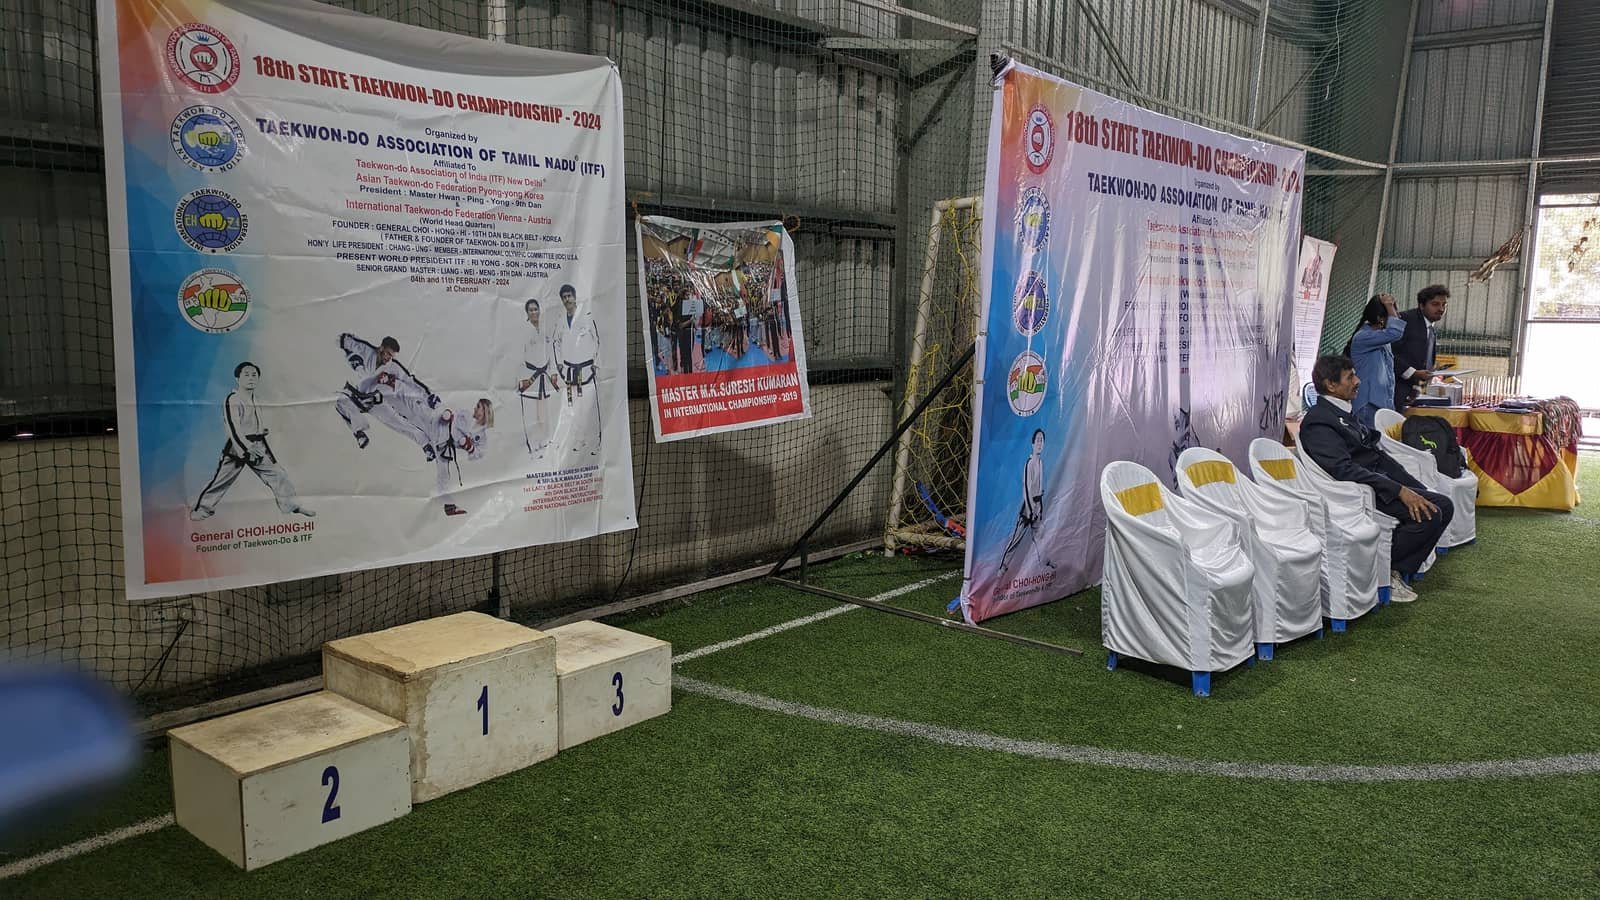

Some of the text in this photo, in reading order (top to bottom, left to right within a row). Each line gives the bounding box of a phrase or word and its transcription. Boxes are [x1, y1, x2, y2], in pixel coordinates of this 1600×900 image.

[253, 55, 295, 80] 18th
[298, 63, 349, 90] STATE
[350, 73, 454, 108] TAEKWON-DO
[456, 93, 562, 124] CHAMPIONSHIP
[573, 110, 601, 130] 2024
[425, 127, 478, 144] Organized by
[256, 118, 369, 145] TAEKWON-DO
[376, 135, 473, 160] ASSOCIATION
[479, 149, 497, 162] OF
[502, 152, 540, 168] TAMIL
[580, 161, 605, 179] (ITF)
[1067, 110, 1099, 147] 18th
[1101, 118, 1139, 156] STATE
[1141, 129, 1212, 173] TAEKWON-DO
[1213, 148, 1277, 187] CHAMPIONSHIP
[356, 159, 408, 173] Taekwon-do
[410, 165, 457, 178] Association
[460, 171, 467, 179] of
[469, 172, 488, 182] India
[489, 175, 506, 184] (ITF)
[508, 177, 523, 185] New
[433, 159, 477, 171] Affiliated To
[356, 172, 545, 200] Asian Taekwon-do Federation Pyong-yong Korea
[359, 184, 402, 196] President
[409, 190, 436, 199] Master
[438, 192, 460, 201] Hwan
[467, 195, 484, 205] Ping
[491, 199, 510, 208] Yong
[1088, 172, 1157, 201] TAEKWON-DO
[1221, 197, 1233, 214] OF
[345, 199, 552, 225] International Taekwon-do Federation Vienna Austria
[445, 219, 463, 227] Head
[224, 213, 249, 253] FEDERATION
[332, 220, 370, 230] FOUNDER
[376, 223, 411, 233] GENERAL
[412, 225, 430, 234] CHOI
[434, 228, 455, 236] HONG
[488, 231, 502, 239] DAN
[502, 232, 524, 240] BLACK
[524, 233, 539, 241] BELT
[542, 235, 562, 243] KOREA
[421, 235, 454, 244] FOUNDER
[455, 237, 464, 245] OF
[332, 240, 347, 249] LIFE
[348, 241, 384, 250] PRESIDENT
[389, 244, 411, 252] CHANG
[415, 245, 428, 253] UNG
[434, 246, 458, 255] MEMBER
[462, 248, 504, 257] INTERNATIONAL
[336, 252, 377, 261] PRESENT
[378, 254, 409, 263] WORLD
[410, 256, 452, 265] PRESIDENT
[480, 259, 500, 267] YONG
[505, 260, 520, 268] SON
[524, 261, 538, 269] DPR
[538, 262, 561, 270] KOREA
[356, 263, 382, 272] SENIOR
[383, 265, 407, 273] GRAND
[410, 266, 436, 274] MASTER
[440, 267, 459, 275] LIANG
[479, 269, 496, 277] MENG
[427, 276, 439, 284] and
[441, 276, 455, 284] 11th
[456, 277, 491, 285] FEBRUARY
[453, 285, 479, 293] Chennai
[661, 372, 799, 404] MASTER M.K.SURESH KUMARAN
[663, 391, 798, 419] IN INTERNATIONAL CHAMPIONSHIP 2019
[190, 521, 315, 543] General CHOI-HONG-HI
[196, 533, 313, 553] Founder of Taekwon-Do & ITF
[611, 671, 625, 717] 3
[477, 685, 489, 736] 1
[320, 765, 341, 824] 2
